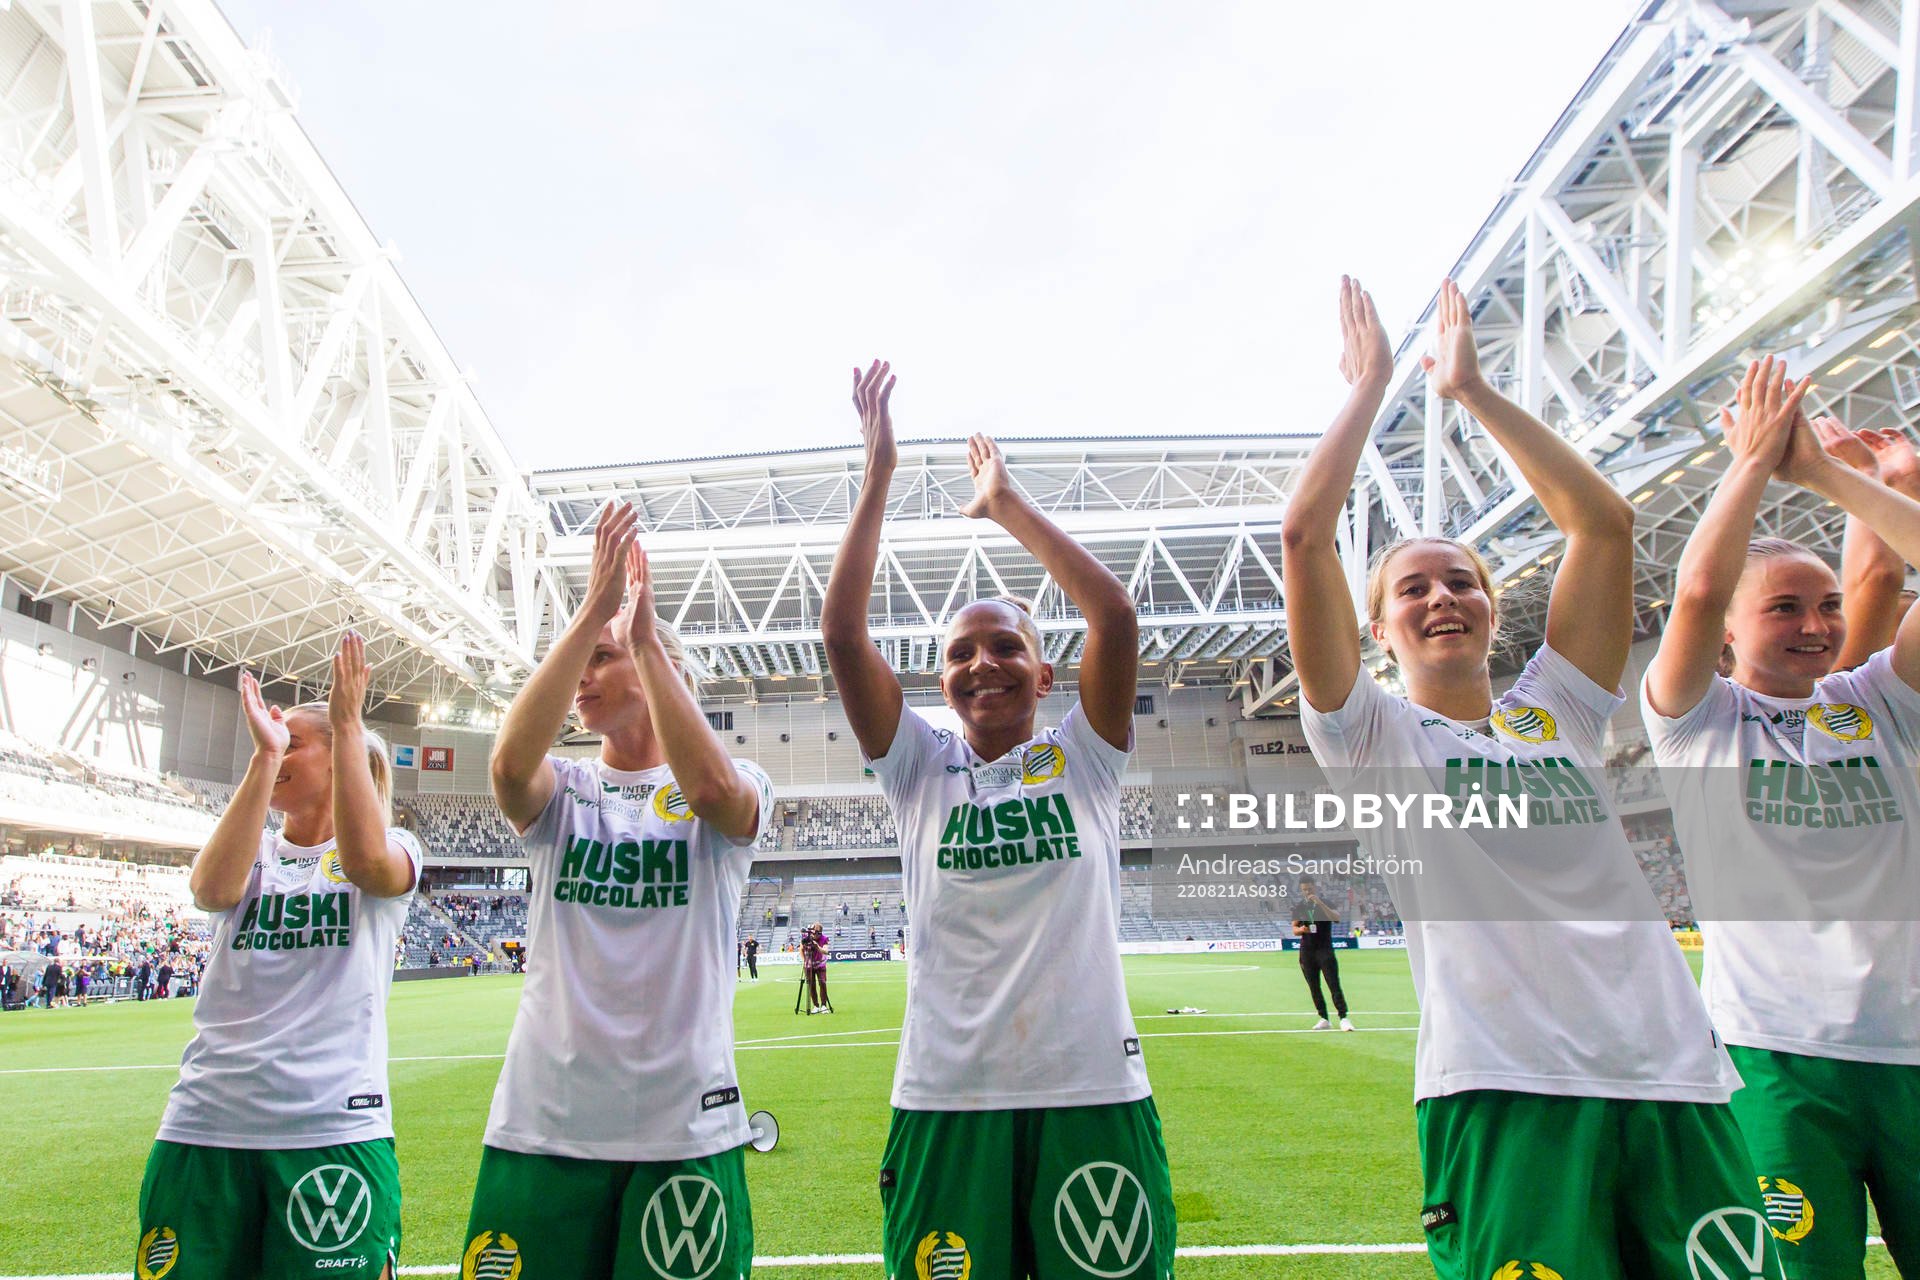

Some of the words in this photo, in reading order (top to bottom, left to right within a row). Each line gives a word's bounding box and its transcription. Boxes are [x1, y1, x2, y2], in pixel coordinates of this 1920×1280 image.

[429, 750, 445, 761] JOB
[1249, 740, 1285, 755] TELE2
[427, 761, 449, 769] ZONE
[1444, 755, 1596, 799] HUSKI
[1746, 756, 1893, 806] HUSKI
[940, 793, 1076, 845] HUSKI
[1746, 800, 1904, 829] CHOCOLATE
[560, 834, 689, 884] HUSKI
[937, 836, 1082, 870] CHOCOLATE
[554, 880, 689, 908] CHOCOLATE
[239, 892, 350, 931] HUSKI
[231, 928, 350, 951] CHOCOLATE
[1217, 941, 1276, 950] INTERSPORT
[315, 1258, 359, 1269] CRAFT
